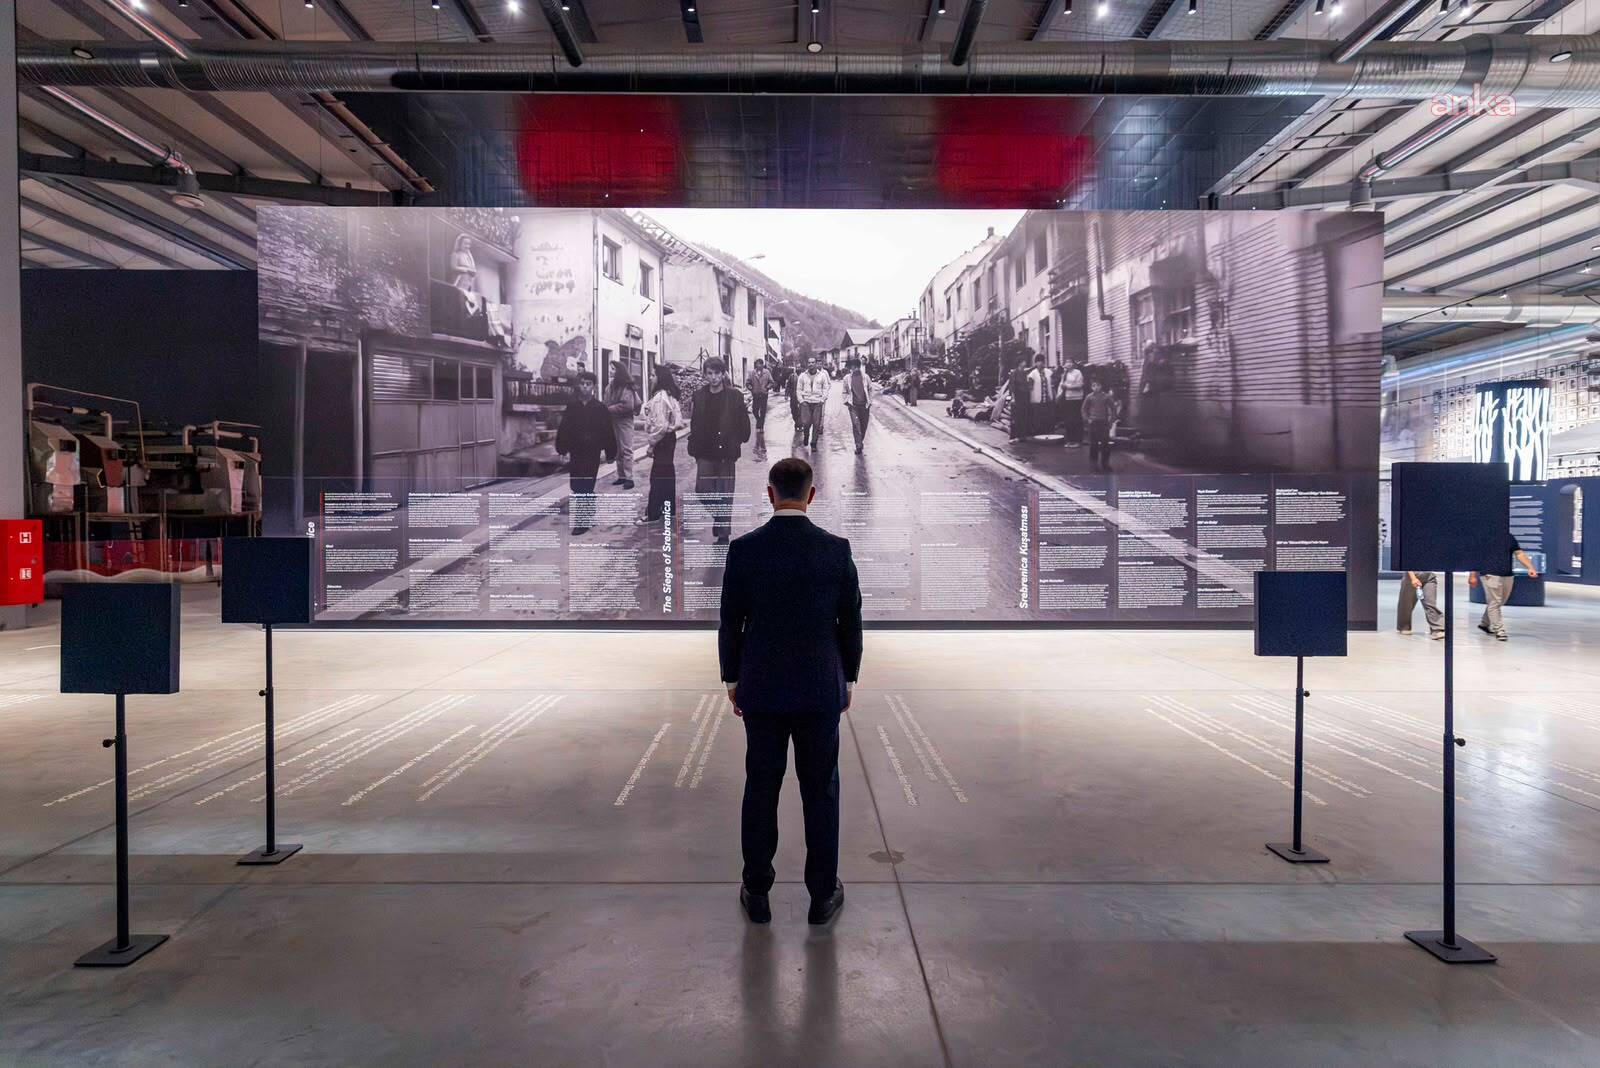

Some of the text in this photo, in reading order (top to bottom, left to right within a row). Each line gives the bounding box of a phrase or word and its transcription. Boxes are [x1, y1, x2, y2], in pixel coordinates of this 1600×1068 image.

[662, 500, 673, 613] The Siege of Srebrenica
[1019, 505, 1030, 609] Srebrenica Kuşatması
